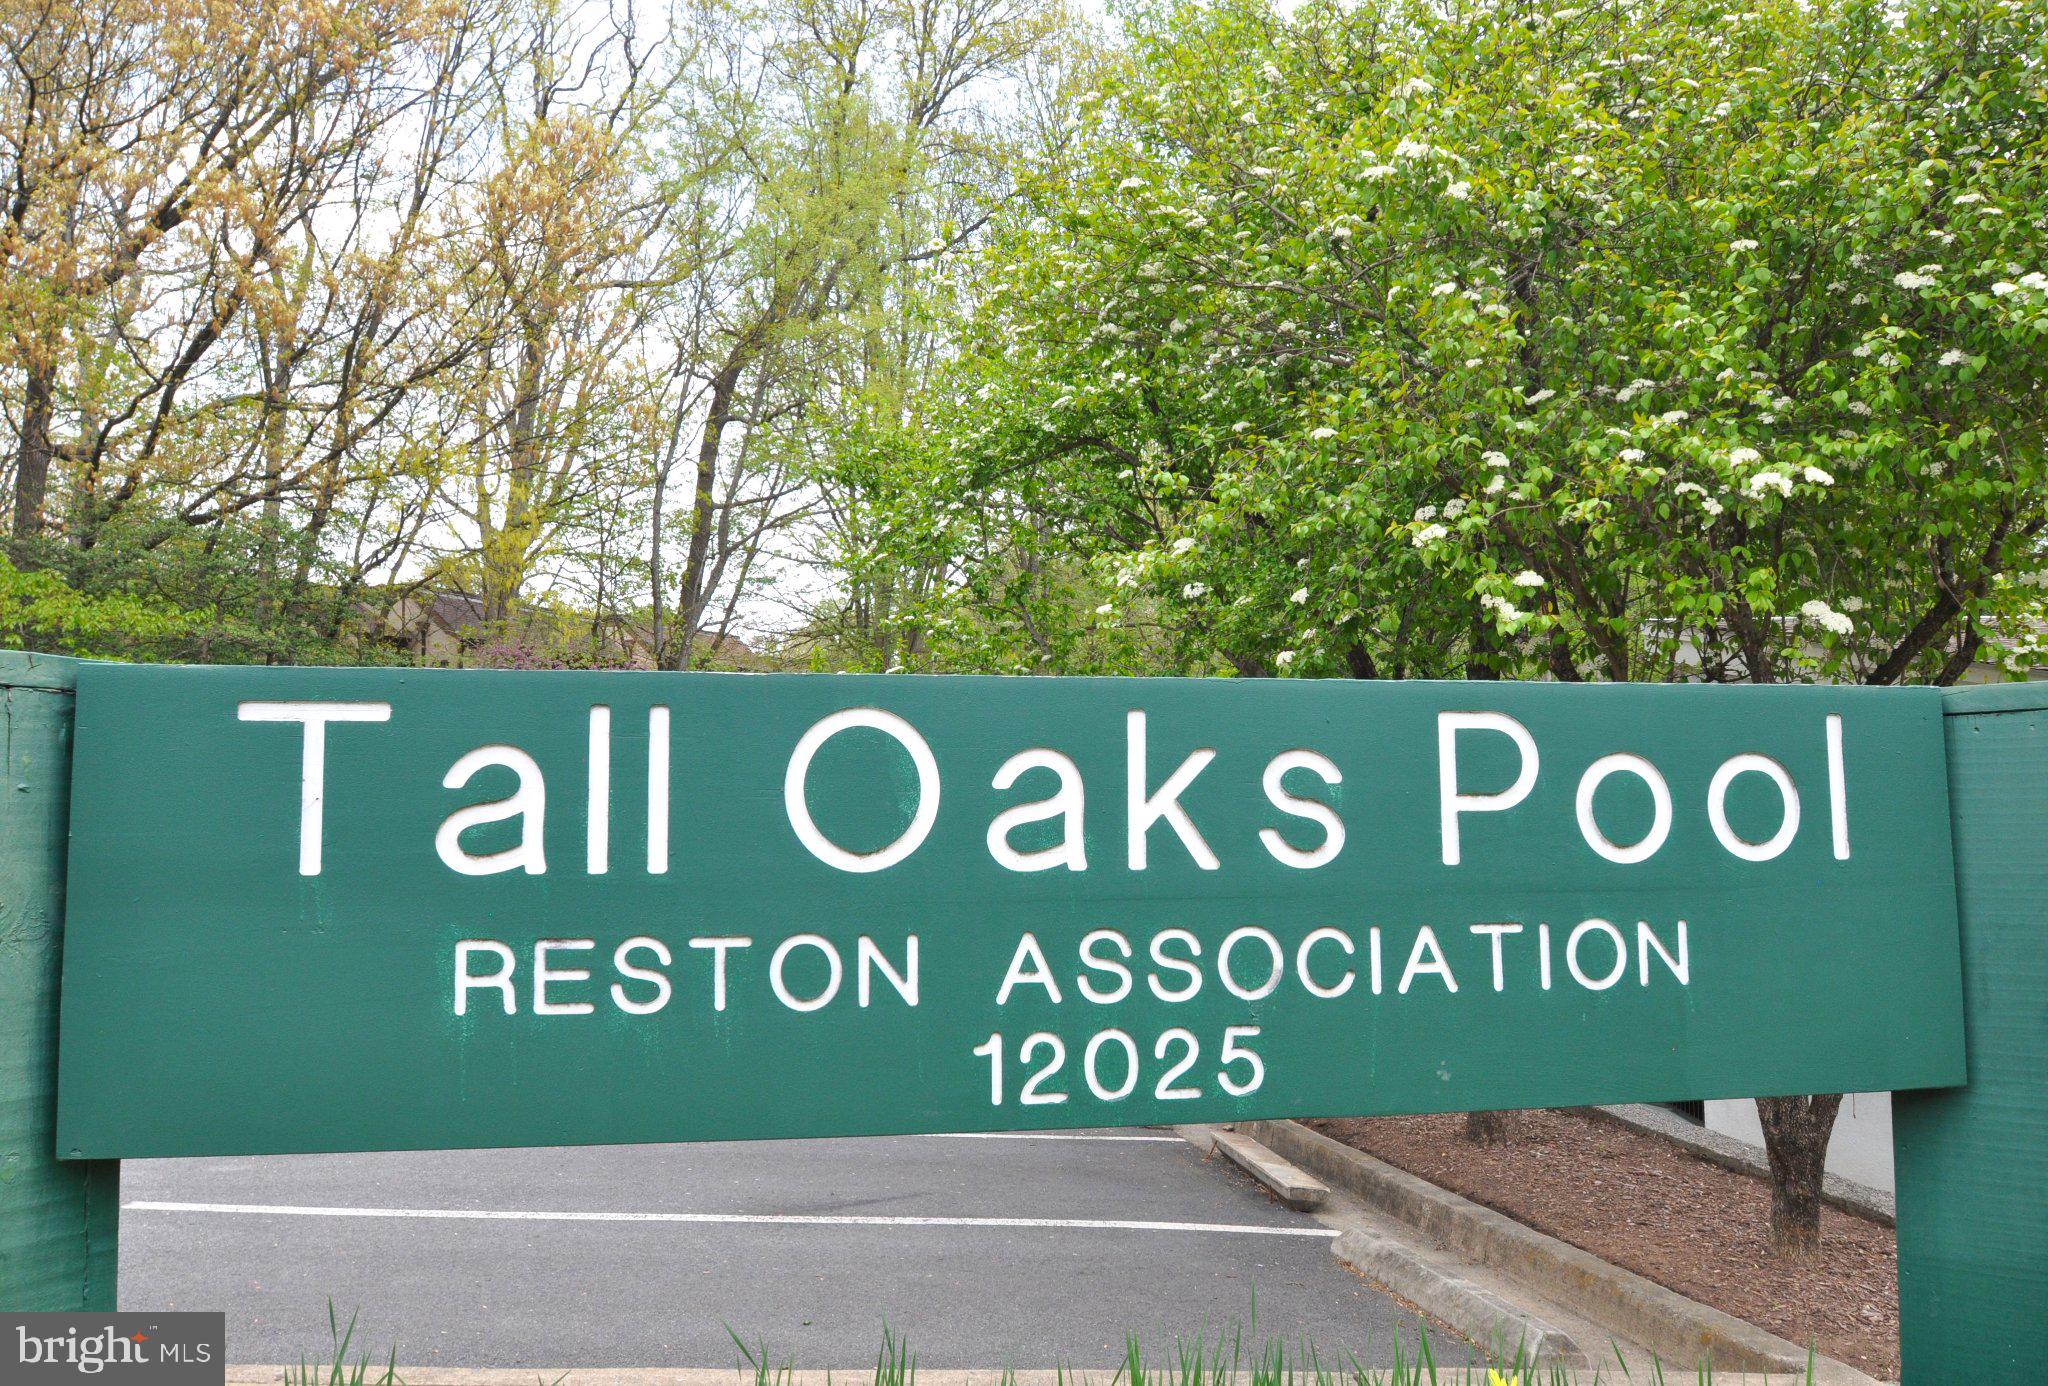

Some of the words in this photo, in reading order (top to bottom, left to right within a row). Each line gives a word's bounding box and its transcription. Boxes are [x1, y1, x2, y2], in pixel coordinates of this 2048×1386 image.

[236, 702, 671, 877] Tall
[783, 706, 1346, 875] Oaks
[1437, 712, 1852, 866] Pool
[453, 933, 920, 1017] RESTON
[995, 918, 1691, 1007] ASSOCIATION
[973, 1026, 1266, 1107] 12025
